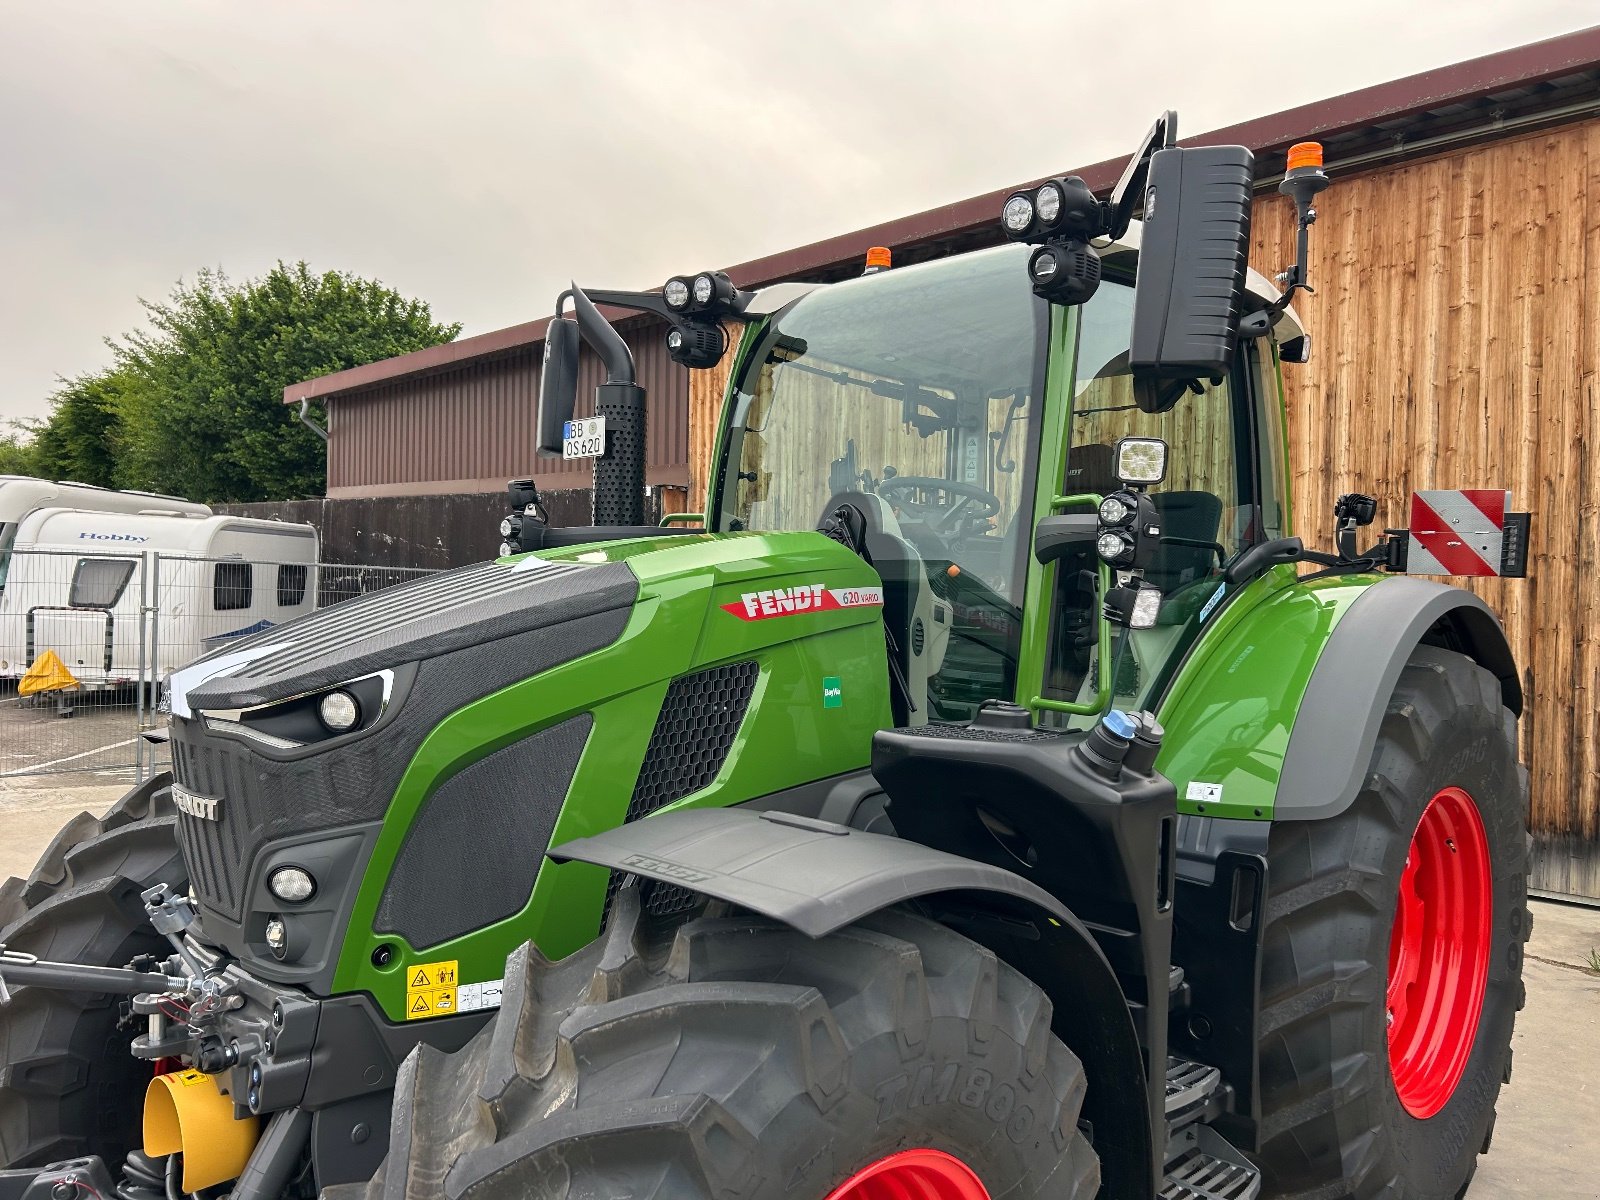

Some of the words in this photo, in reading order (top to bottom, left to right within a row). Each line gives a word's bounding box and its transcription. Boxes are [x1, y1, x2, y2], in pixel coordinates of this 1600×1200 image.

[571, 423, 583, 438] BB
[79, 533, 150, 543] Hobby
[741, 584, 825, 617] FENDT
[843, 591, 860, 604] 620
[860, 593, 879, 602] VARIO
[824, 687, 841, 698] BayWa
[171, 785, 218, 820] FENDT
[622, 856, 712, 882] FENDT
[875, 1062, 1035, 1144] TM800
